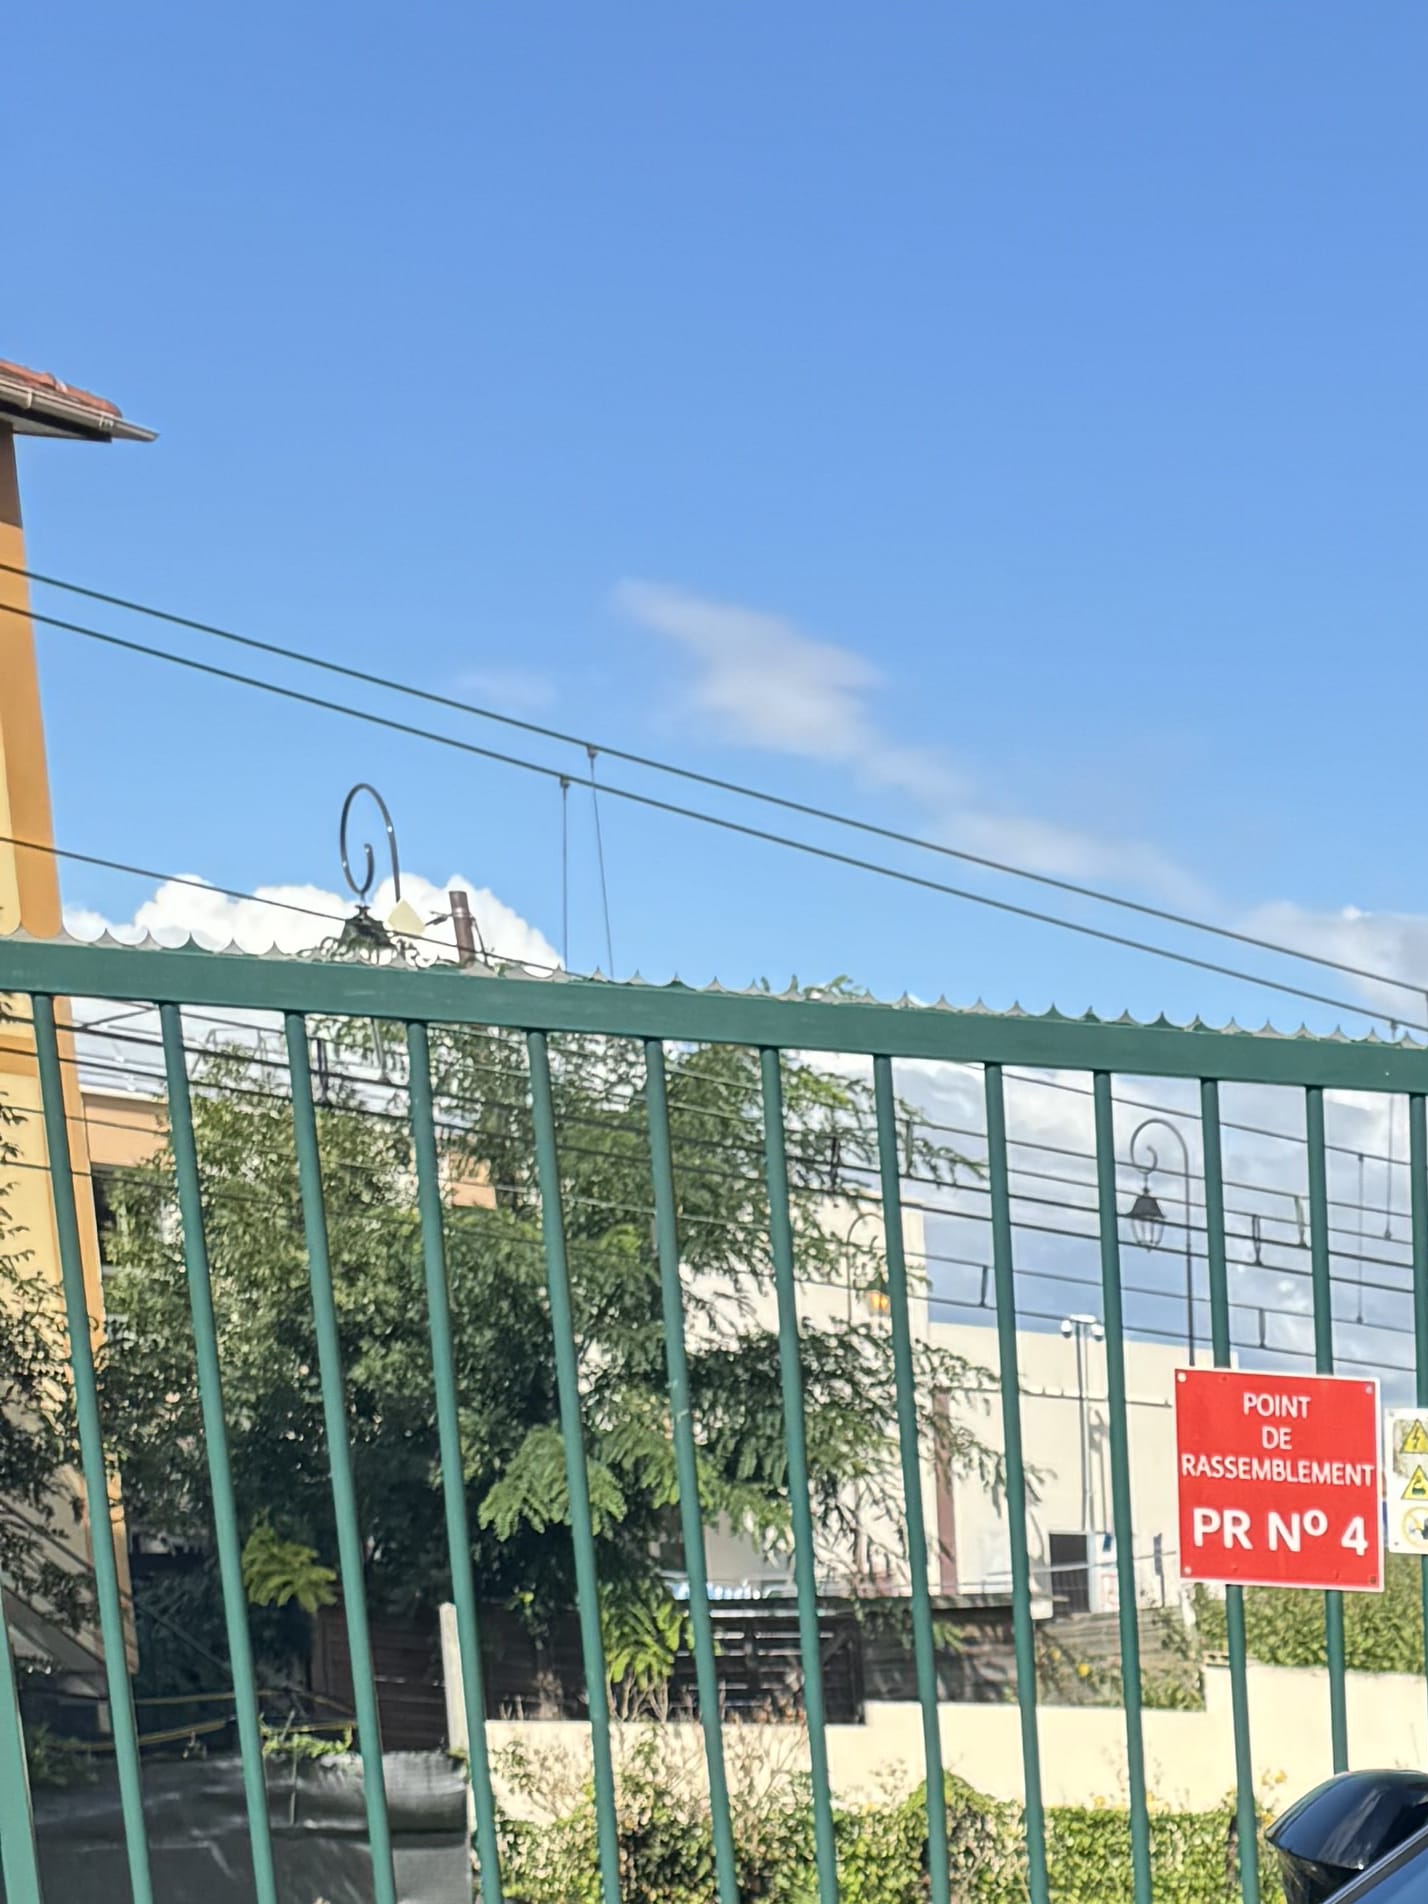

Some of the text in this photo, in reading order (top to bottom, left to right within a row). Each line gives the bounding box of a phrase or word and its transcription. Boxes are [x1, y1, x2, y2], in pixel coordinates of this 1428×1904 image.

[1243, 1392, 1311, 1419] POINT
[1261, 1425, 1292, 1450] DE
[1181, 1453, 1375, 1487] RASSEMBLEMENT
[1193, 1507, 1253, 1550] PR
[1340, 1515, 1368, 1556] 4
